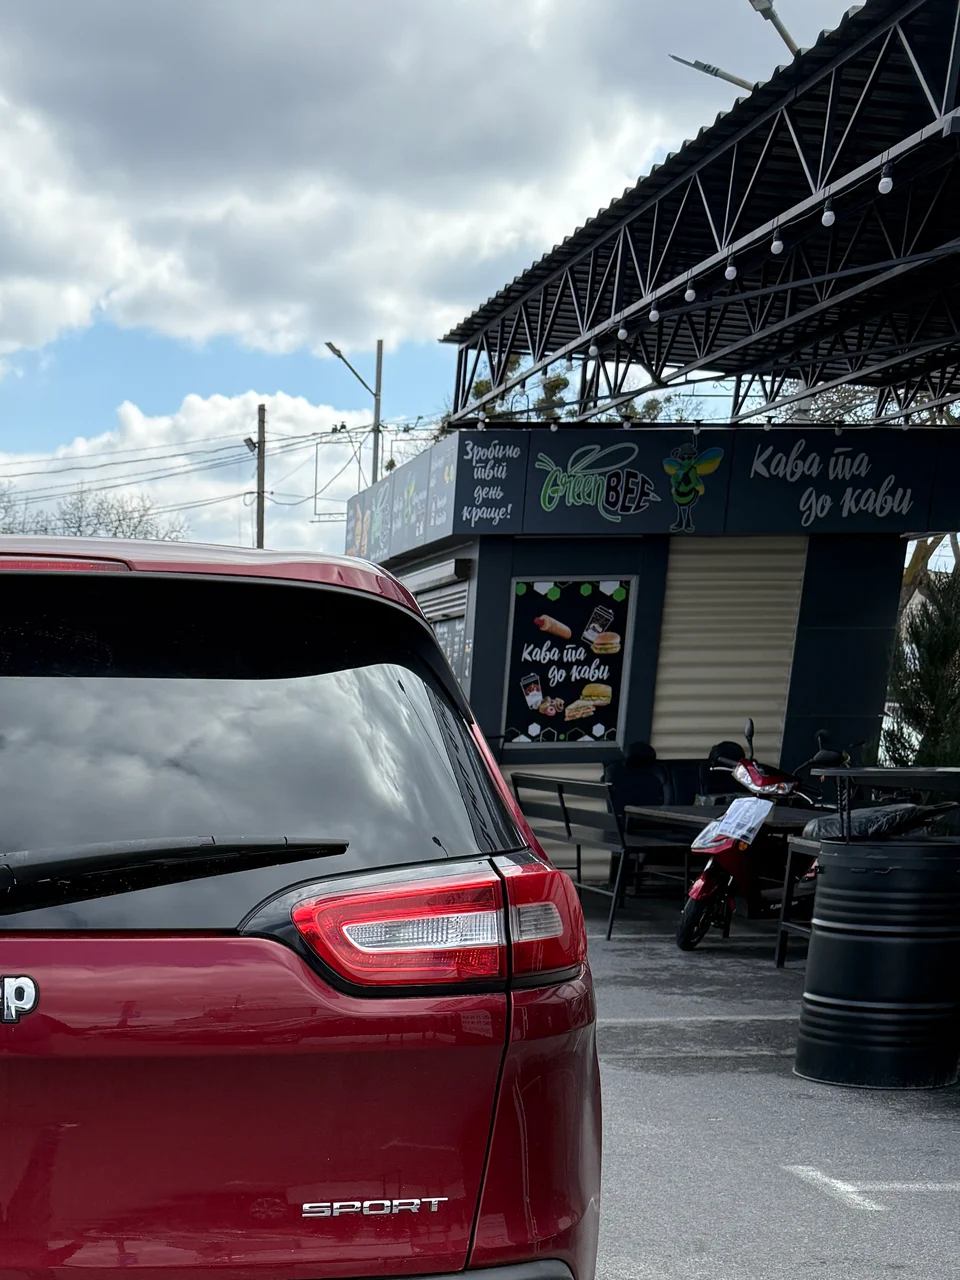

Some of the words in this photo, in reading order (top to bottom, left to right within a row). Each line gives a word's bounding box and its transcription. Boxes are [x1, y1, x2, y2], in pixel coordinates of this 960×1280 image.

[463, 440, 521, 466] Зробимо
[750, 438, 824, 483] Кава
[828, 447, 872, 481] та
[473, 460, 508, 480] твій
[473, 485, 504, 505] день
[799, 486, 834, 527] до
[840, 474, 914, 518] кави
[461, 503, 513, 528] краще!
[521, 639, 561, 664] Кава
[563, 644, 588, 663] та
[548, 664, 567, 688] до
[570, 657, 610, 682] кави
[301, 1197, 449, 1217] SPORT
